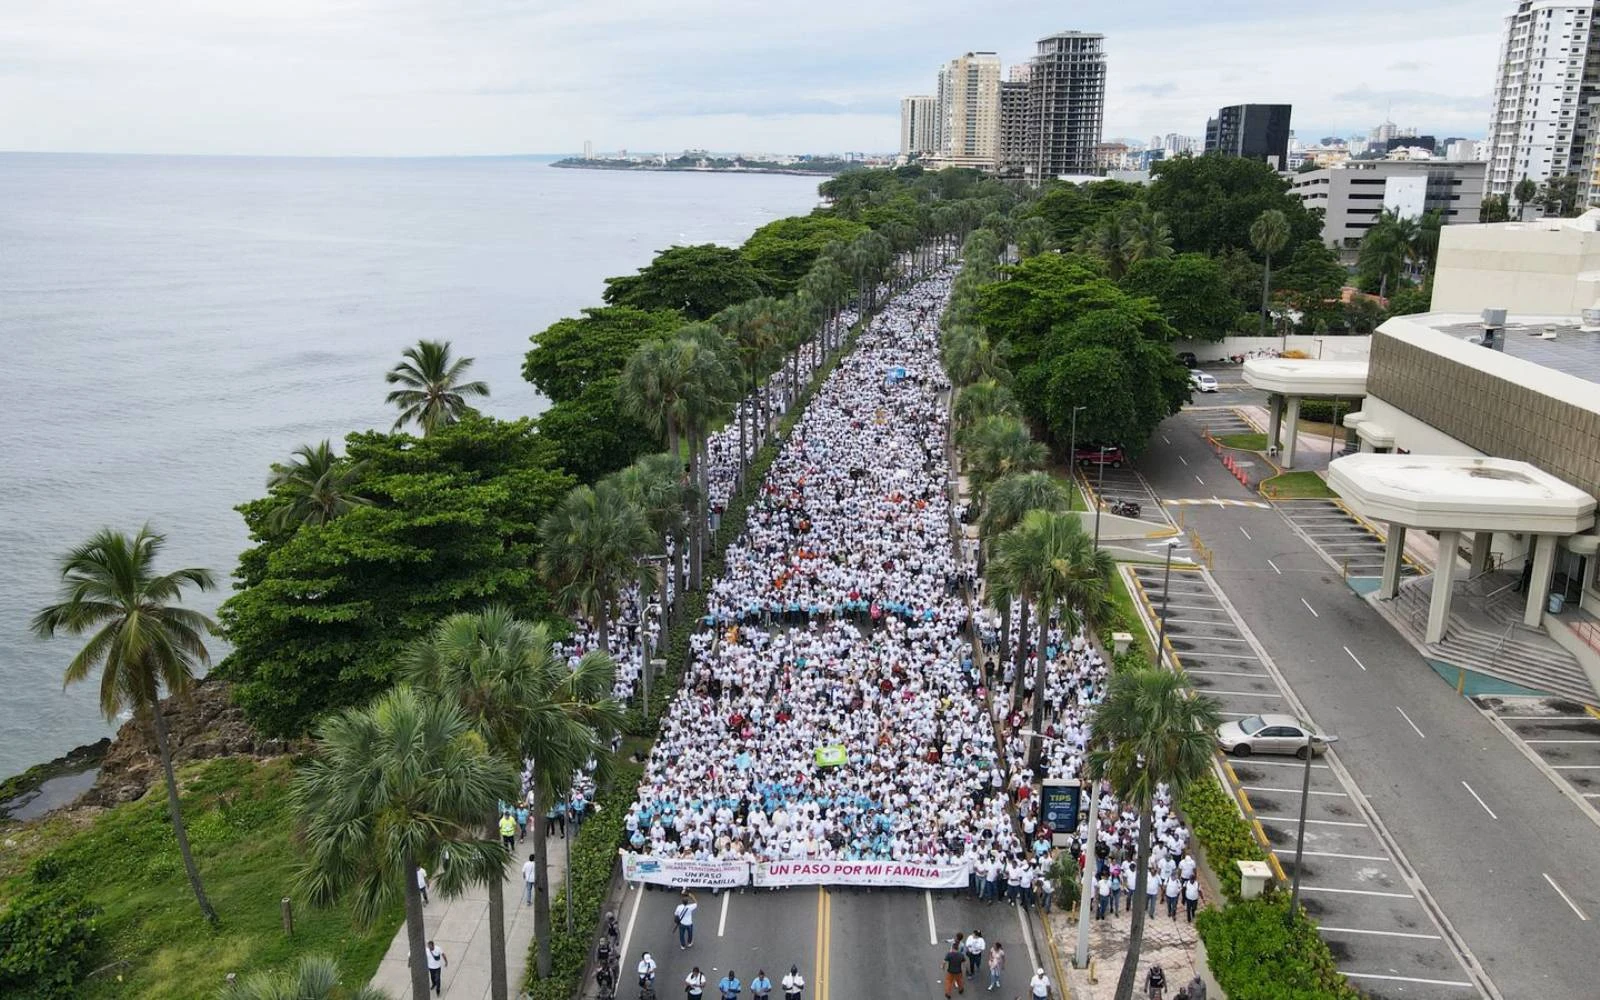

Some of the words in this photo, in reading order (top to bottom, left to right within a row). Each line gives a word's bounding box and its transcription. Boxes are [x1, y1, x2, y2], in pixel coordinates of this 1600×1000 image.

[1050, 794, 1072, 802] TIPS
[769, 864, 790, 875] UN
[793, 864, 831, 875] PASO
[833, 864, 862, 875] POR
[865, 865, 883, 875] MI
[885, 865, 940, 878] FAMILIA
